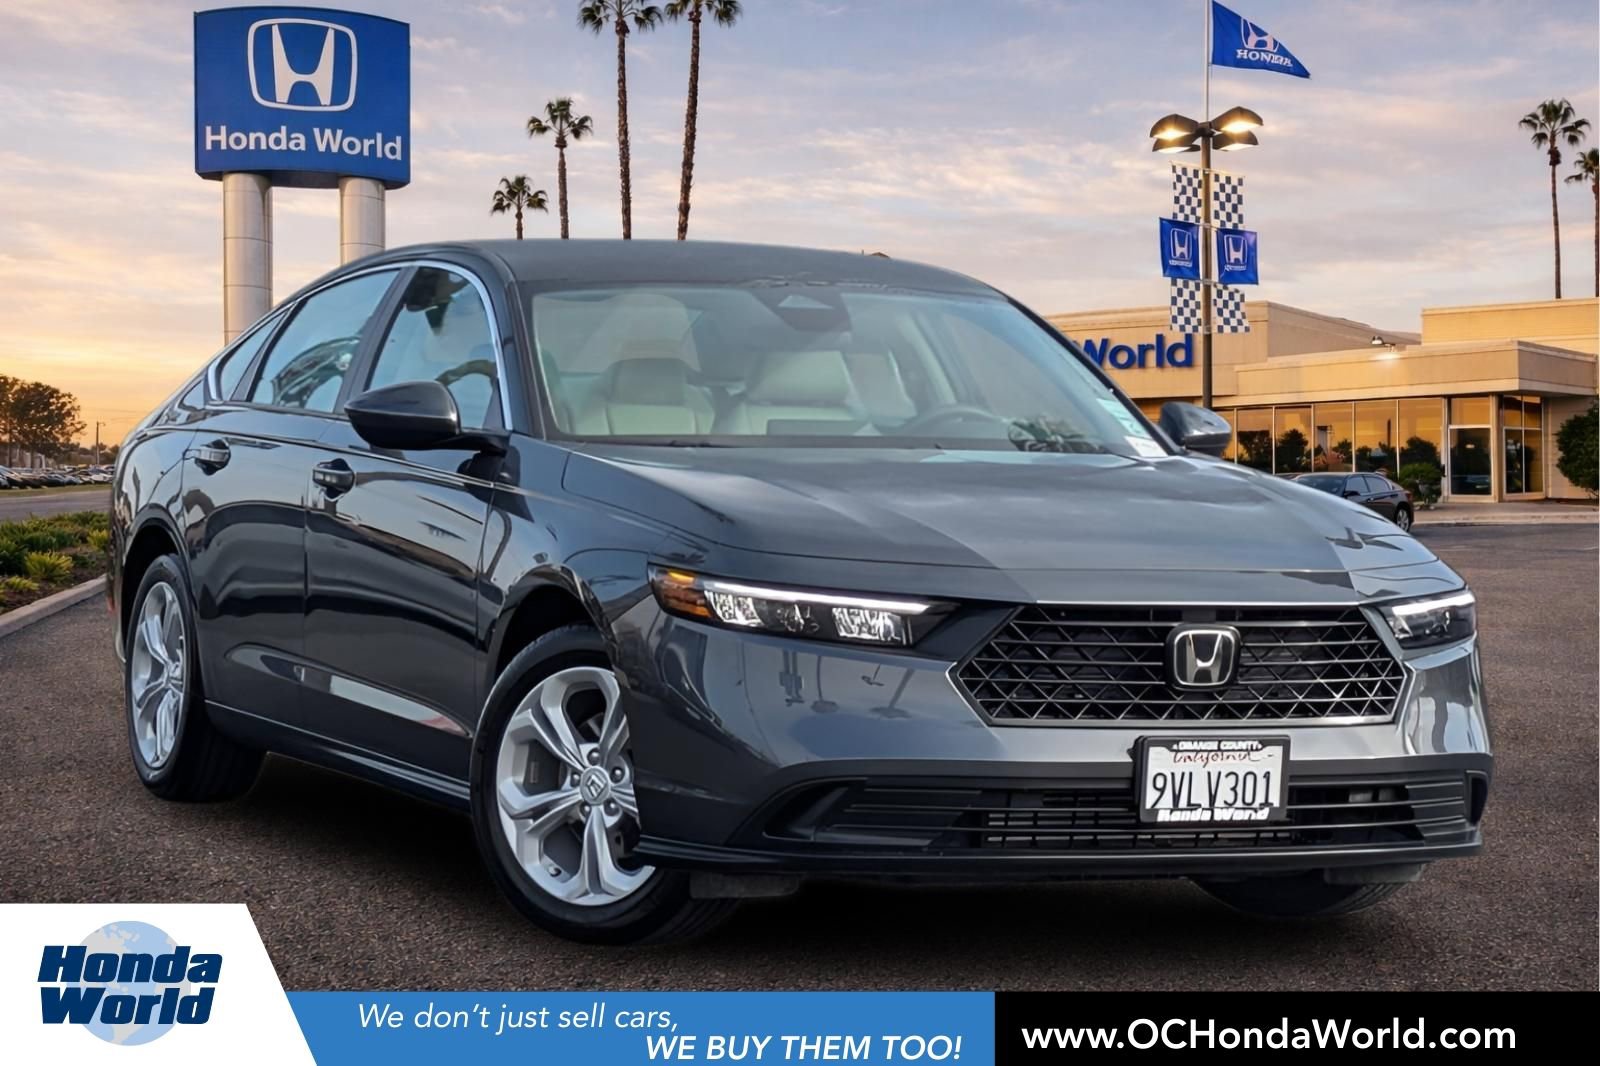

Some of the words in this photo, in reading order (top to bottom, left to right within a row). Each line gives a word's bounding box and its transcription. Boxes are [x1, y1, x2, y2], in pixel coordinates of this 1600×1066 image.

[205, 125, 306, 151] Honda
[313, 127, 402, 161] World
[1150, 770, 1274, 809] 9VLV301
